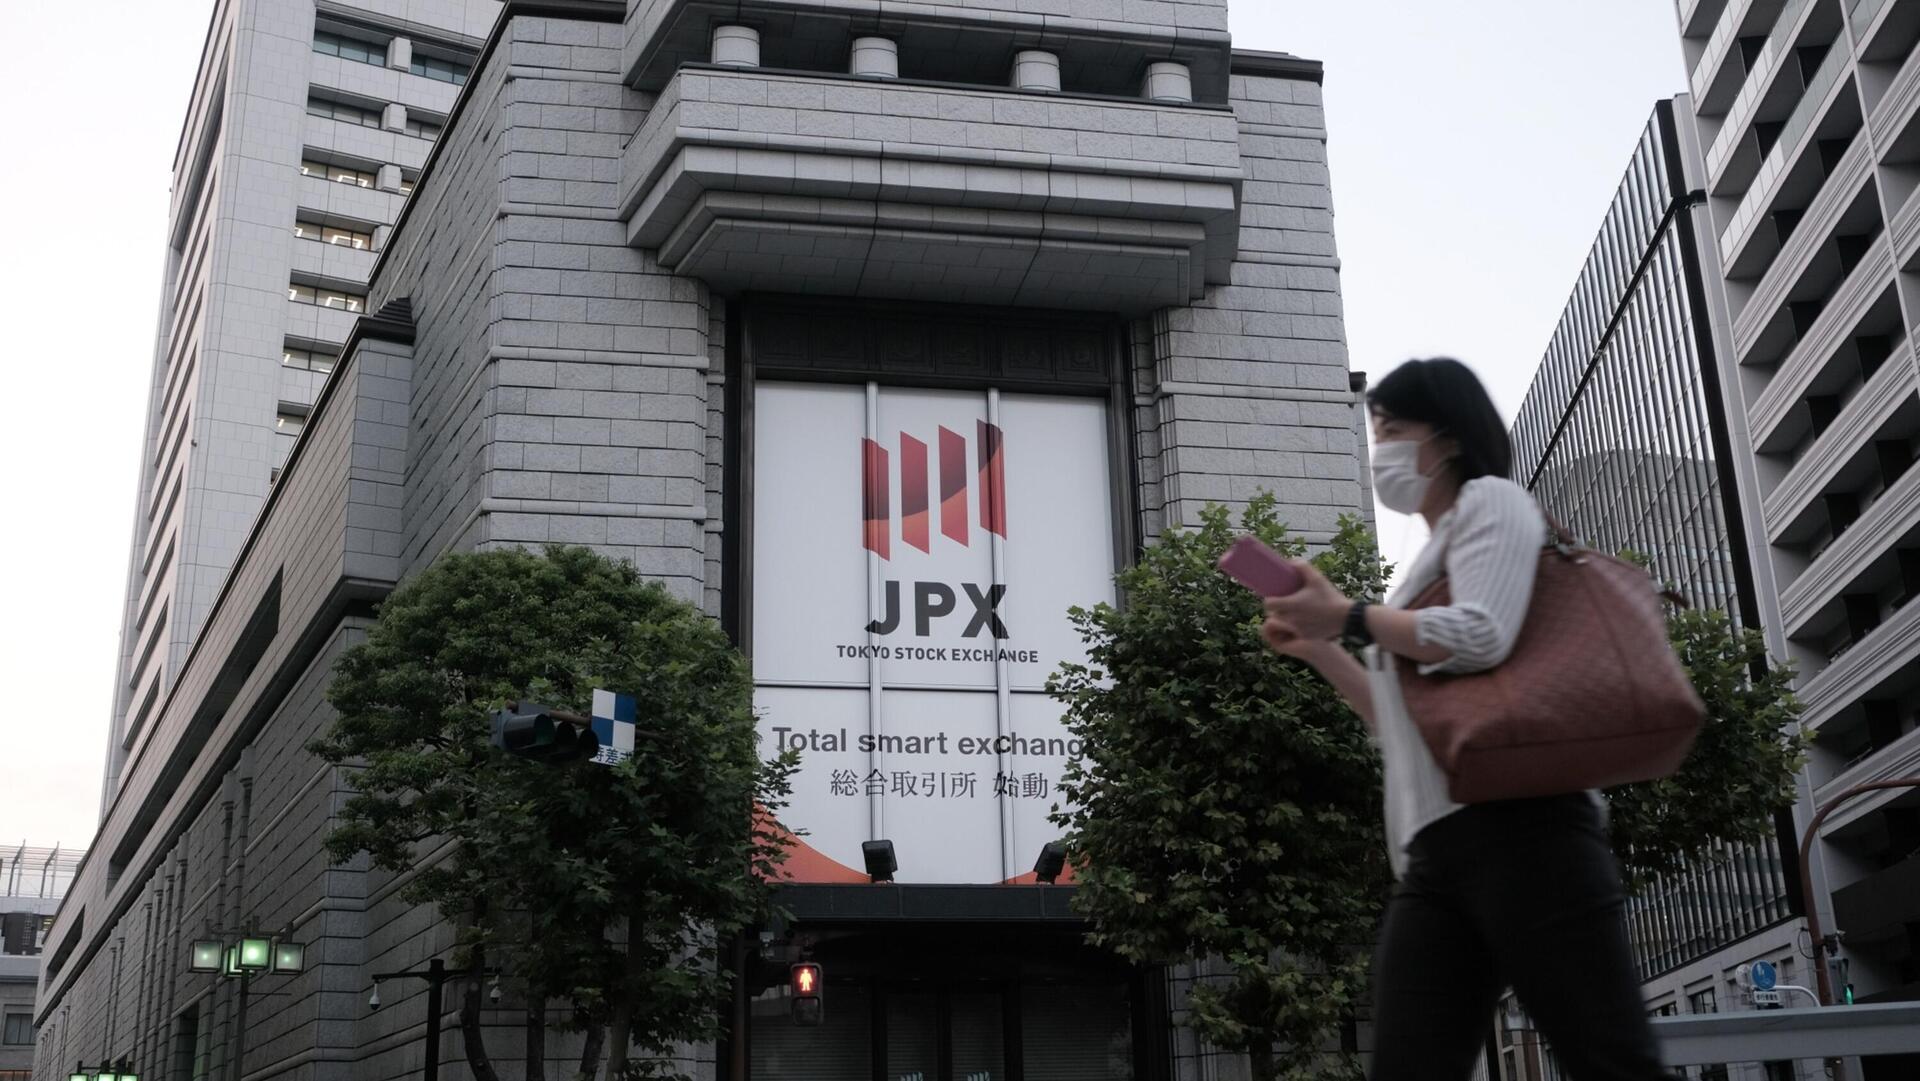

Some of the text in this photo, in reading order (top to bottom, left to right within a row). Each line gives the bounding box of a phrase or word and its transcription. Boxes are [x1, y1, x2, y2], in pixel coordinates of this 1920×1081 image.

[864, 580, 1010, 640] JPX
[836, 645, 1039, 663] TOKYO STOCK EXCHANGE
[772, 727, 1088, 762] Total smart exchang
[830, 768, 1048, 799] 総合取引所 始動
